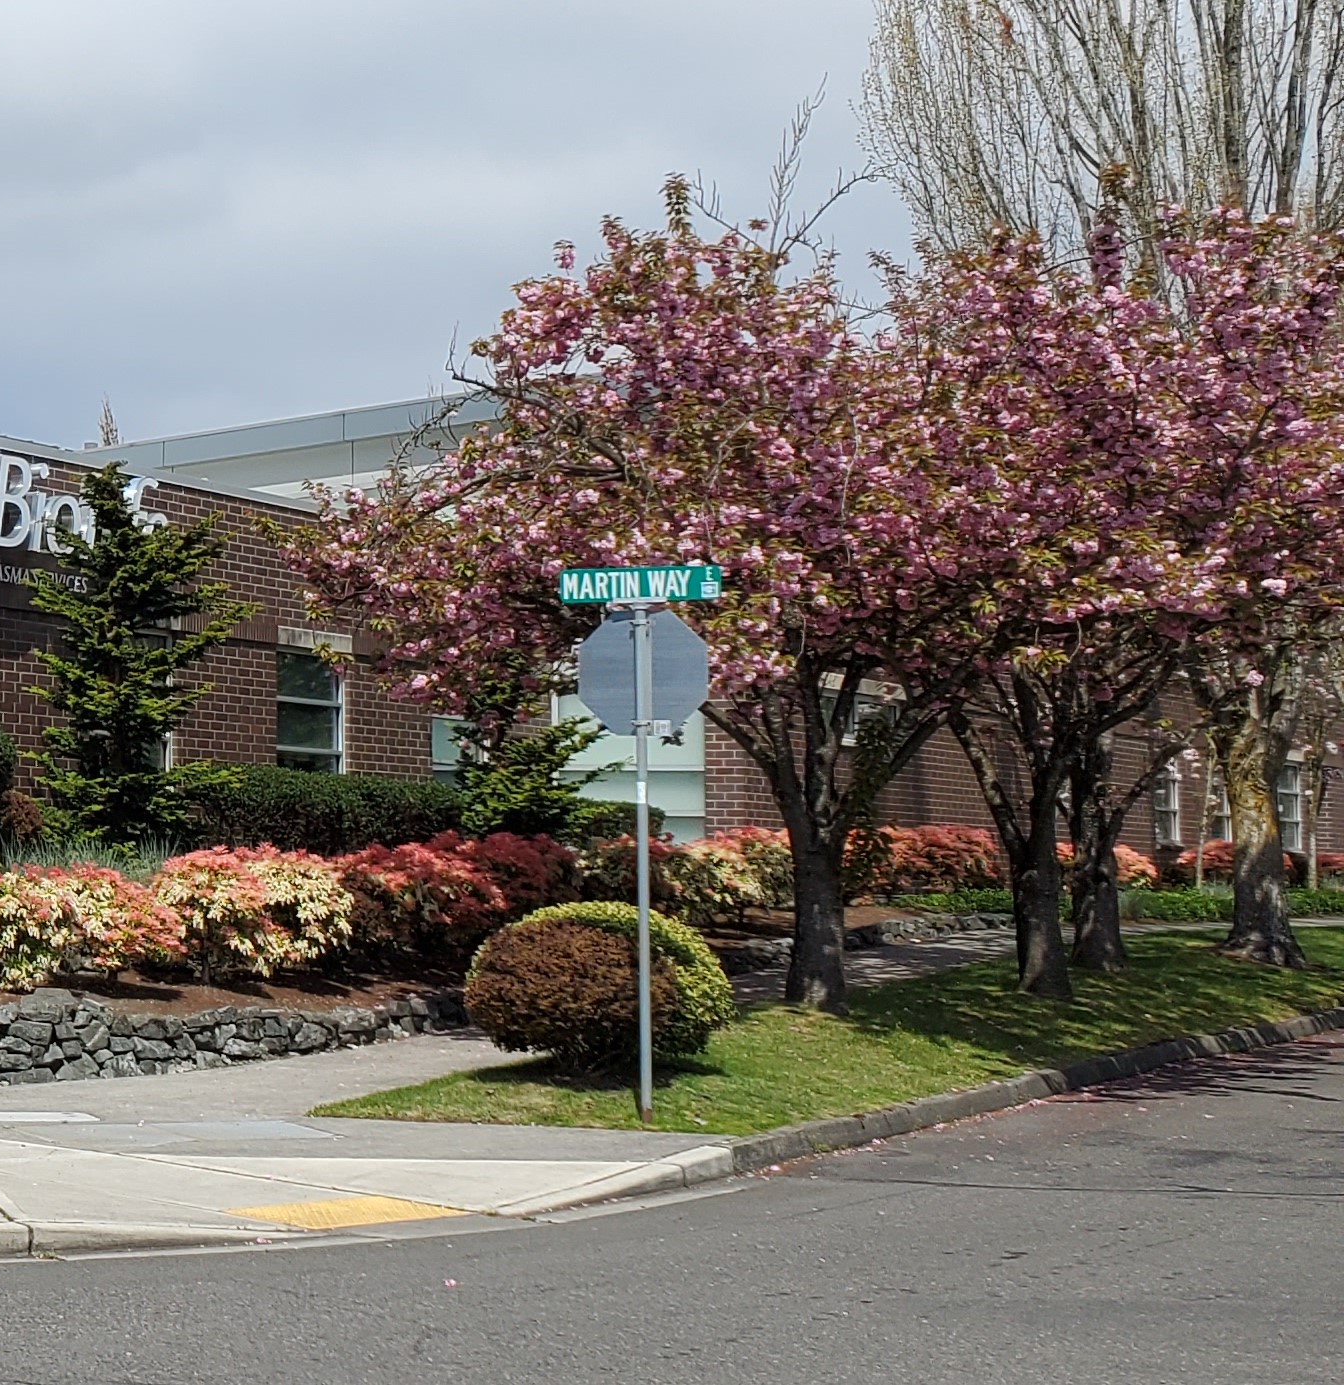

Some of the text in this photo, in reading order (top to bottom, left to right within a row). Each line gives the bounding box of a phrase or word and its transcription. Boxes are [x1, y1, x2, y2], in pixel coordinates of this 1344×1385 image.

[563, 566, 714, 599] MARTIN WAY E
